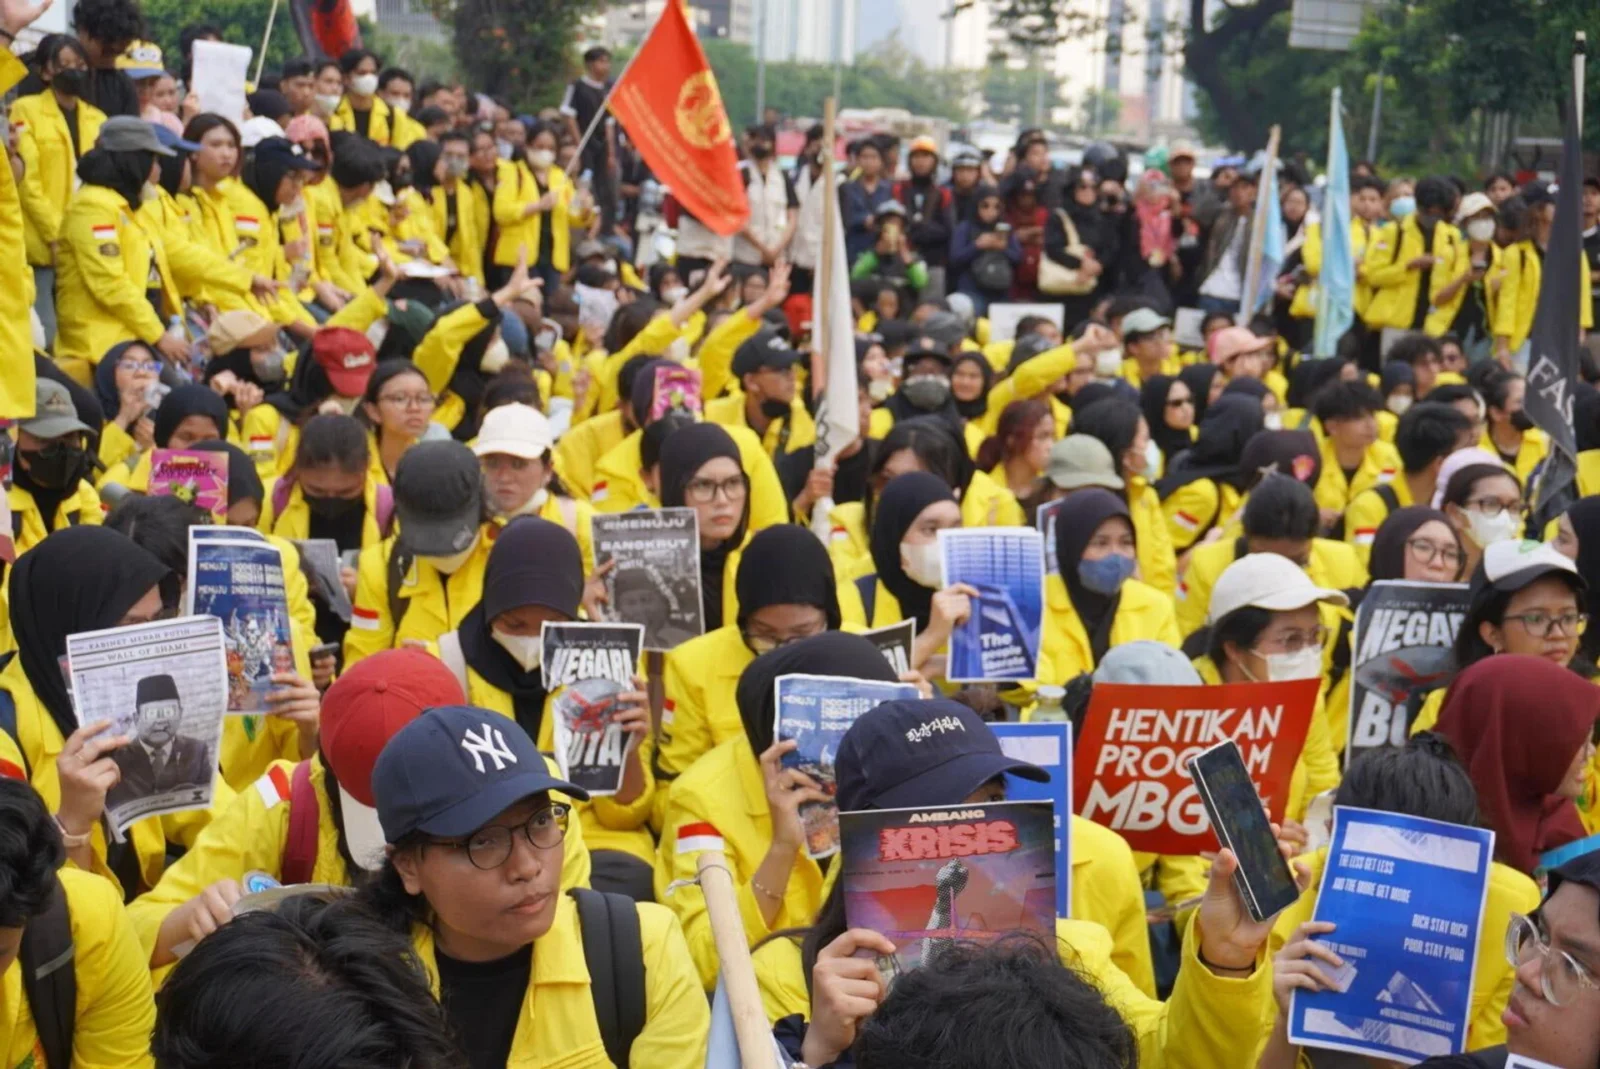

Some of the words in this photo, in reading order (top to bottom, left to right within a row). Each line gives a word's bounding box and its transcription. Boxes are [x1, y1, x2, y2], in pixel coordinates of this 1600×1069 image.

[603, 518, 686, 530] #MENUJU
[601, 538, 689, 551] BANGKRUT
[89, 638, 127, 650] KABINET
[130, 634, 161, 645] MERAH
[980, 632, 1013, 649] The
[1356, 608, 1466, 666] NEGA
[107, 651, 136, 662] WALL
[138, 647, 151, 657] OF
[155, 642, 189, 654] SHAME
[1104, 704, 1284, 742] HENTIKAN
[461, 722, 518, 774] NY
[1094, 740, 1273, 778] PROGM
[909, 809, 985, 823] AMBANG
[1079, 778, 1212, 835] MBG
[879, 820, 1021, 862] KRISIS
[1376, 859, 1395, 875] LESS
[1411, 913, 1431, 929] RICH
[1430, 917, 1450, 934] STAY
[1449, 921, 1469, 938] RICH
[1403, 937, 1424, 955] POOR
[1423, 941, 1446, 958] STAY
[1443, 945, 1466, 962] POOR
